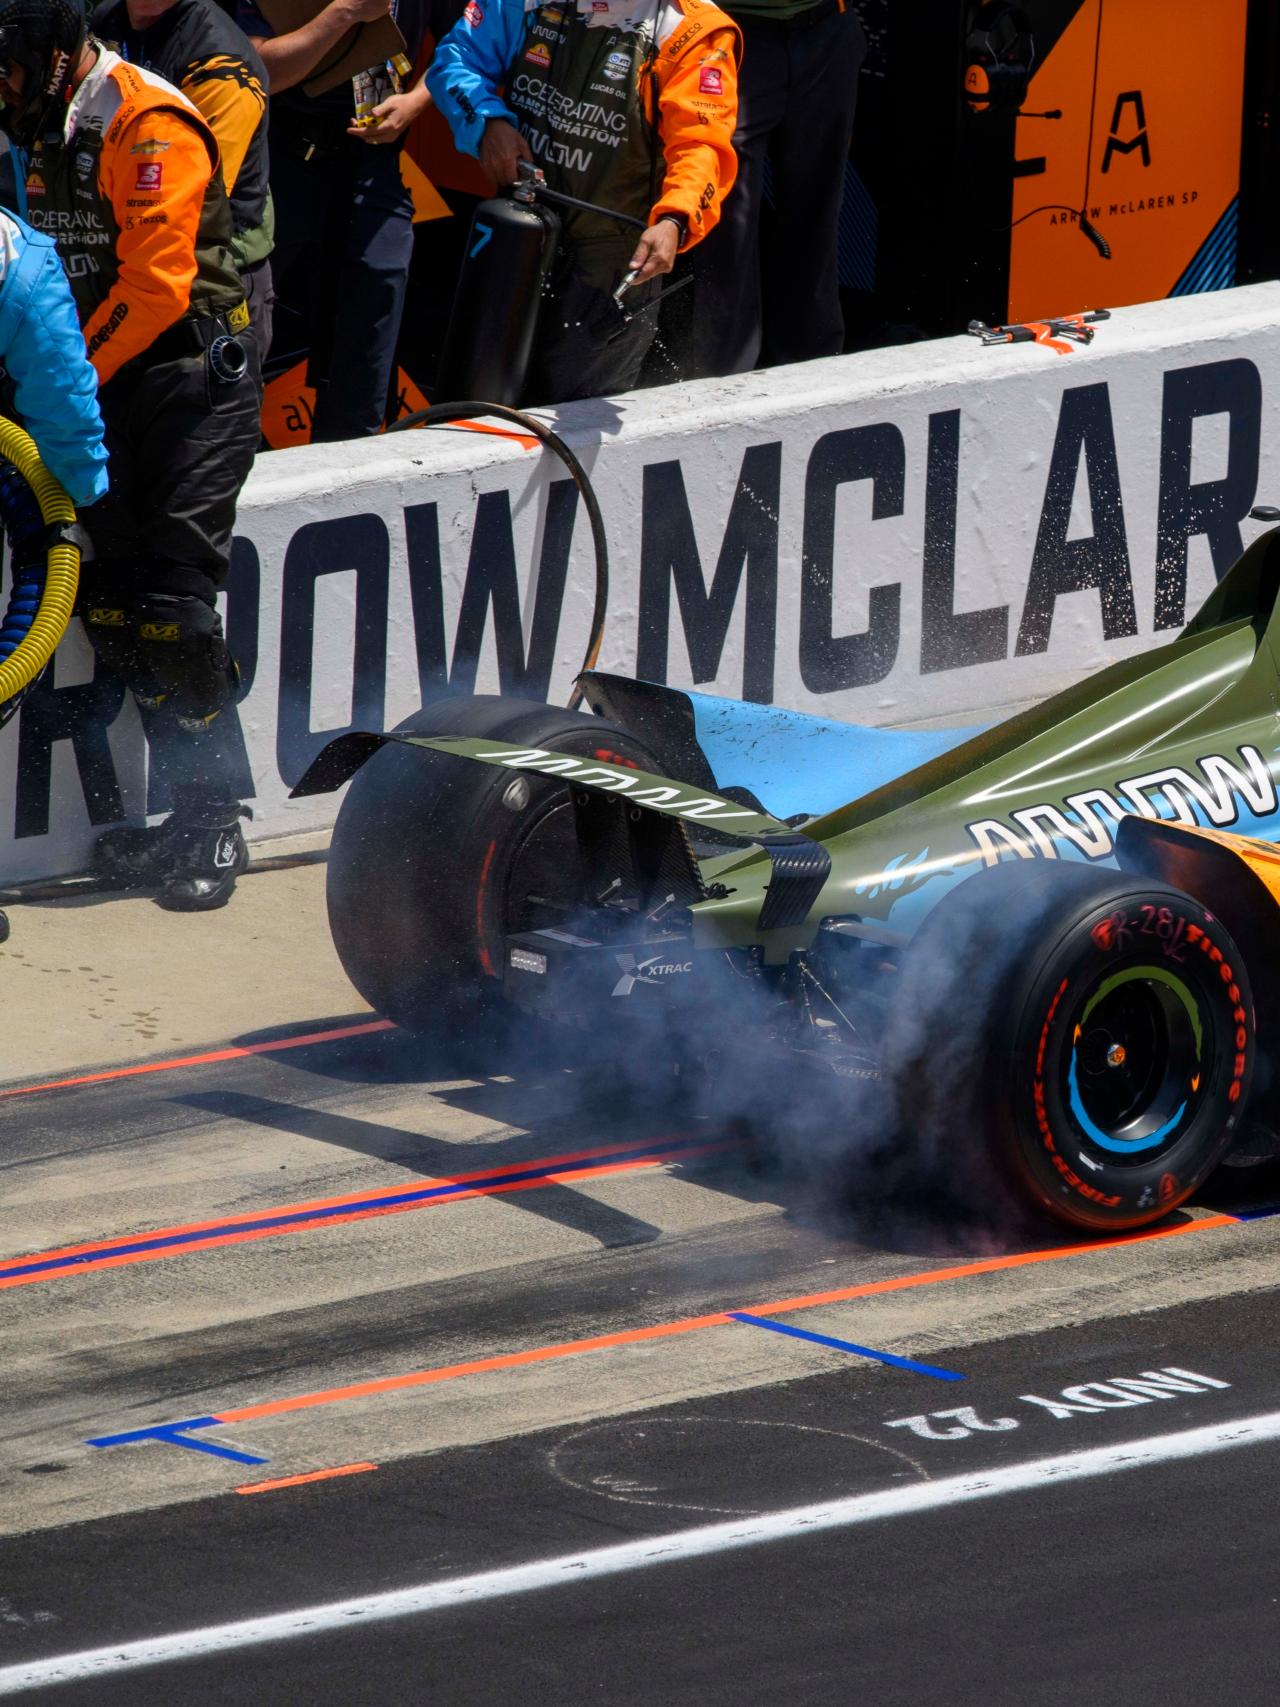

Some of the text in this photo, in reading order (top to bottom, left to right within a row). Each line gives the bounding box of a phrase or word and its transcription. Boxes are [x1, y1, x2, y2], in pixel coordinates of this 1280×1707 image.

[47, 50, 71, 96] MARTY
[513, 74, 627, 132] CCELERATING
[1050, 190, 1199, 226] ARRW McLAREN SP
[470, 221, 494, 258] 7
[648, 961, 694, 976] XTRAC
[1187, 923, 1248, 1103] Firestone
[881, 1366, 1233, 1441] INDY 22
